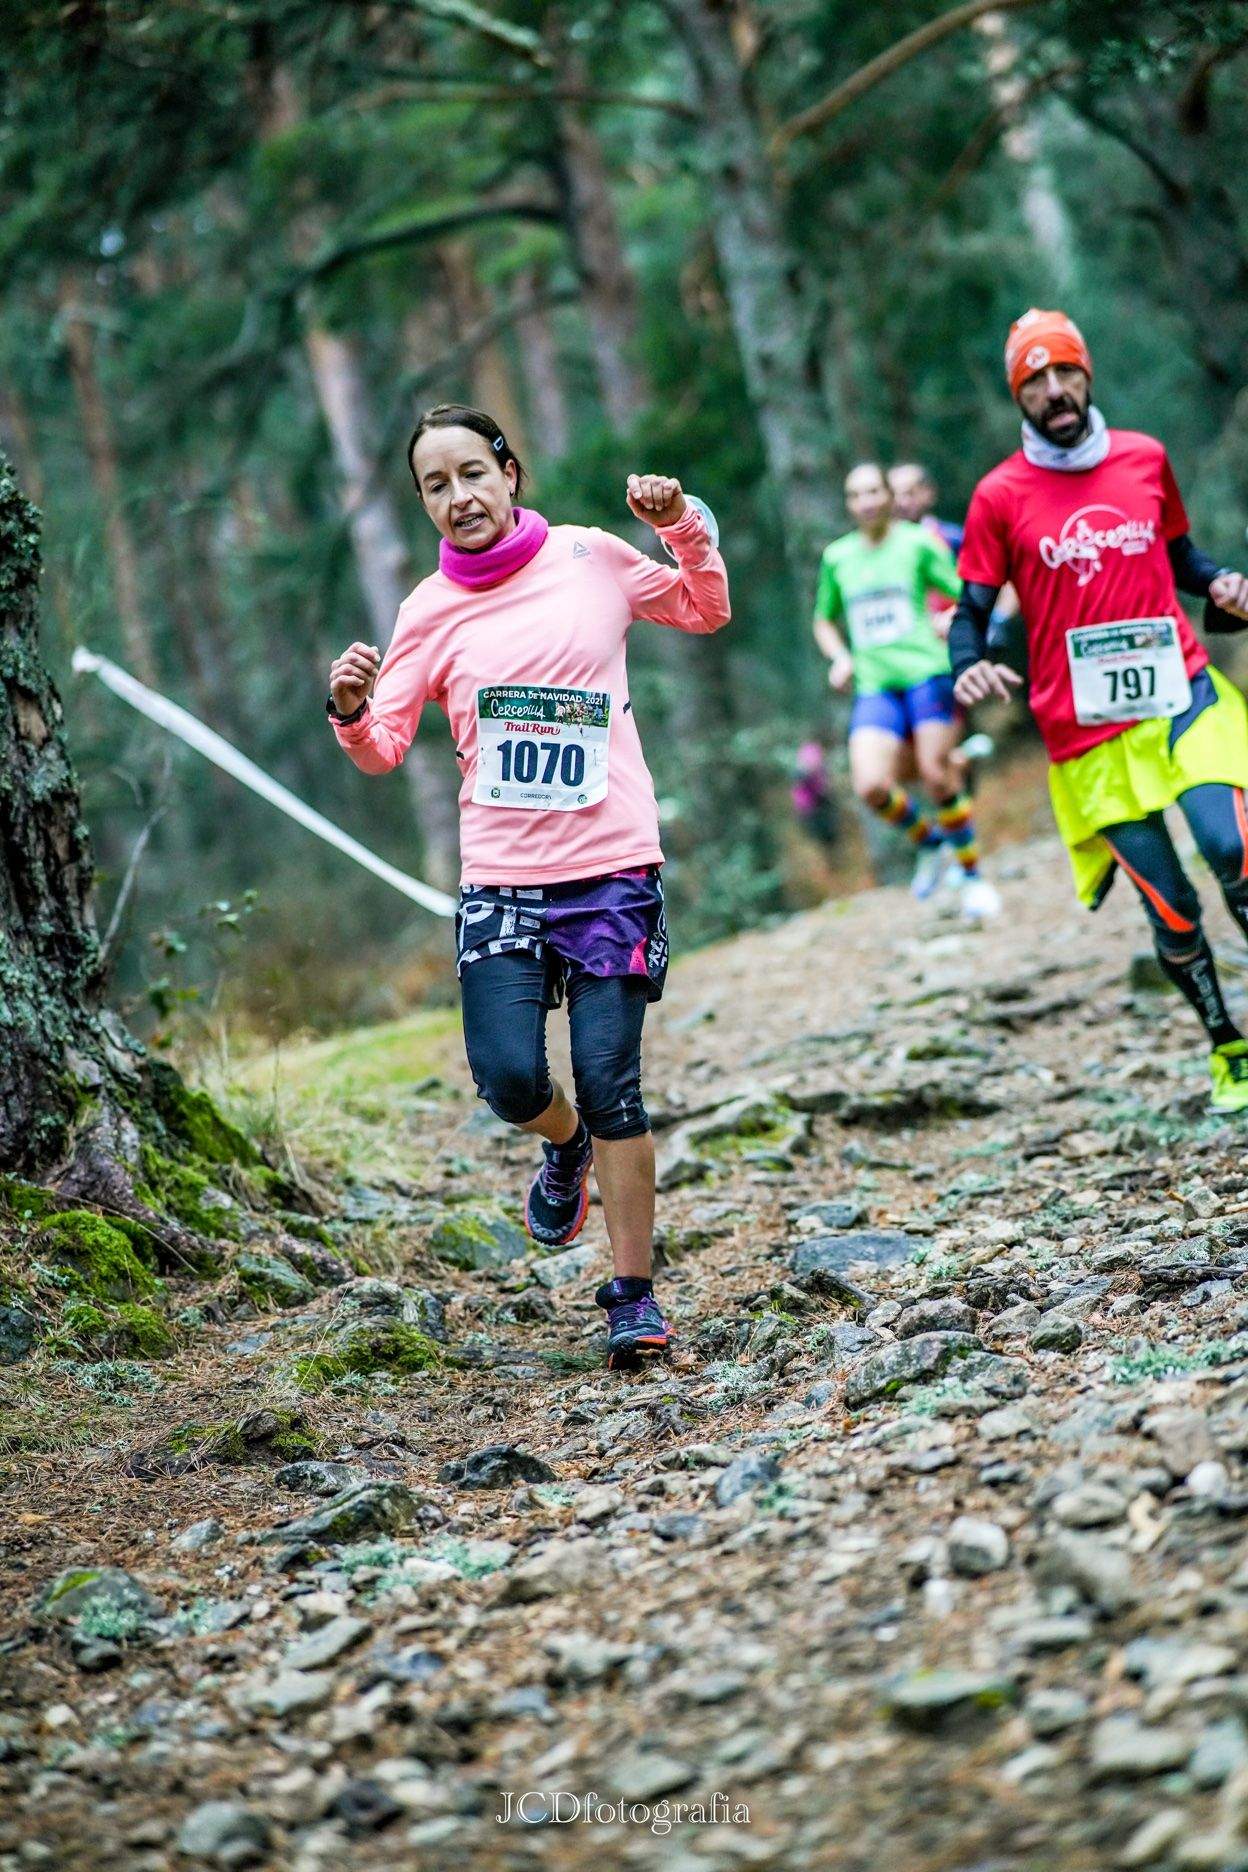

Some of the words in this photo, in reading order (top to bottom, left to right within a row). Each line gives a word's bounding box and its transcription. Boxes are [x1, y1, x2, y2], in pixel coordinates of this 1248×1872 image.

[1103, 666, 1156, 703] 797
[483, 690, 526, 699] CARRERA
[540, 691, 583, 703] NAVIDAD
[585, 697, 604, 706] 2021
[504, 721, 530, 733] Trail
[530, 722, 561, 736] Run
[496, 739, 585, 787] 1070
